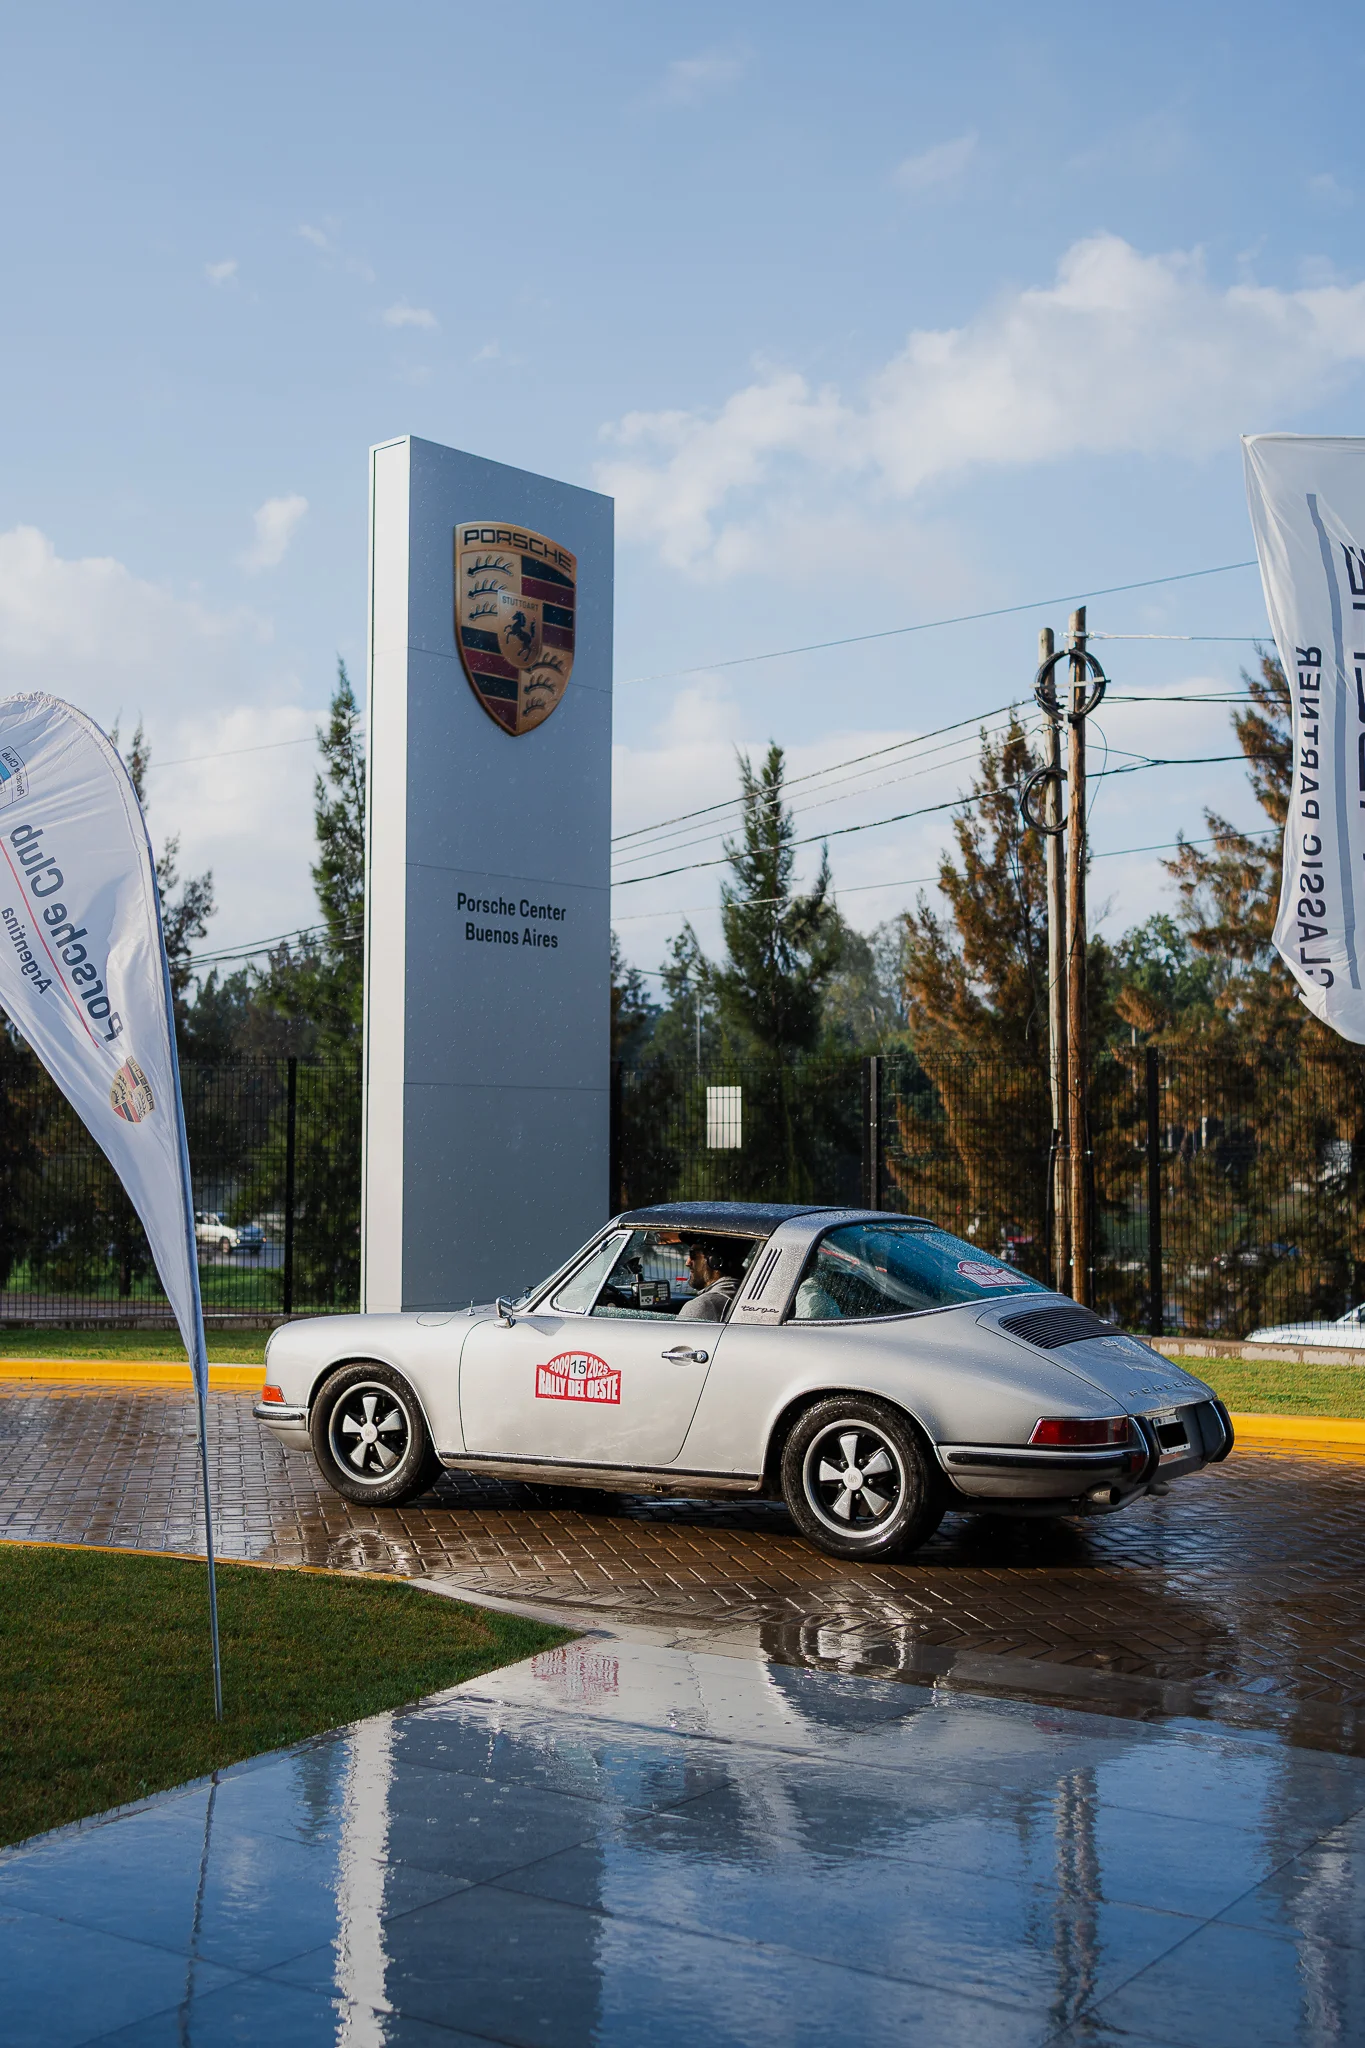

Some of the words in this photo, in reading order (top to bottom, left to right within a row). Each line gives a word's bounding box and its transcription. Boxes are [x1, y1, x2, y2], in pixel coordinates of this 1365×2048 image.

[464, 529, 572, 573] PORSCHE
[502, 596, 539, 611] STUTTGART
[457, 892, 516, 916] Porsche
[519, 899, 566, 921] Center
[465, 922, 519, 945] Buenos
[522, 928, 558, 949] Aires
[549, 1355, 570, 1377] 2009
[570, 1360, 587, 1374] 15
[587, 1357, 609, 1378] 2025
[538, 1368, 567, 1397] RALLY
[567, 1379, 586, 1397] DEL
[586, 1374, 618, 1401] OESTE
